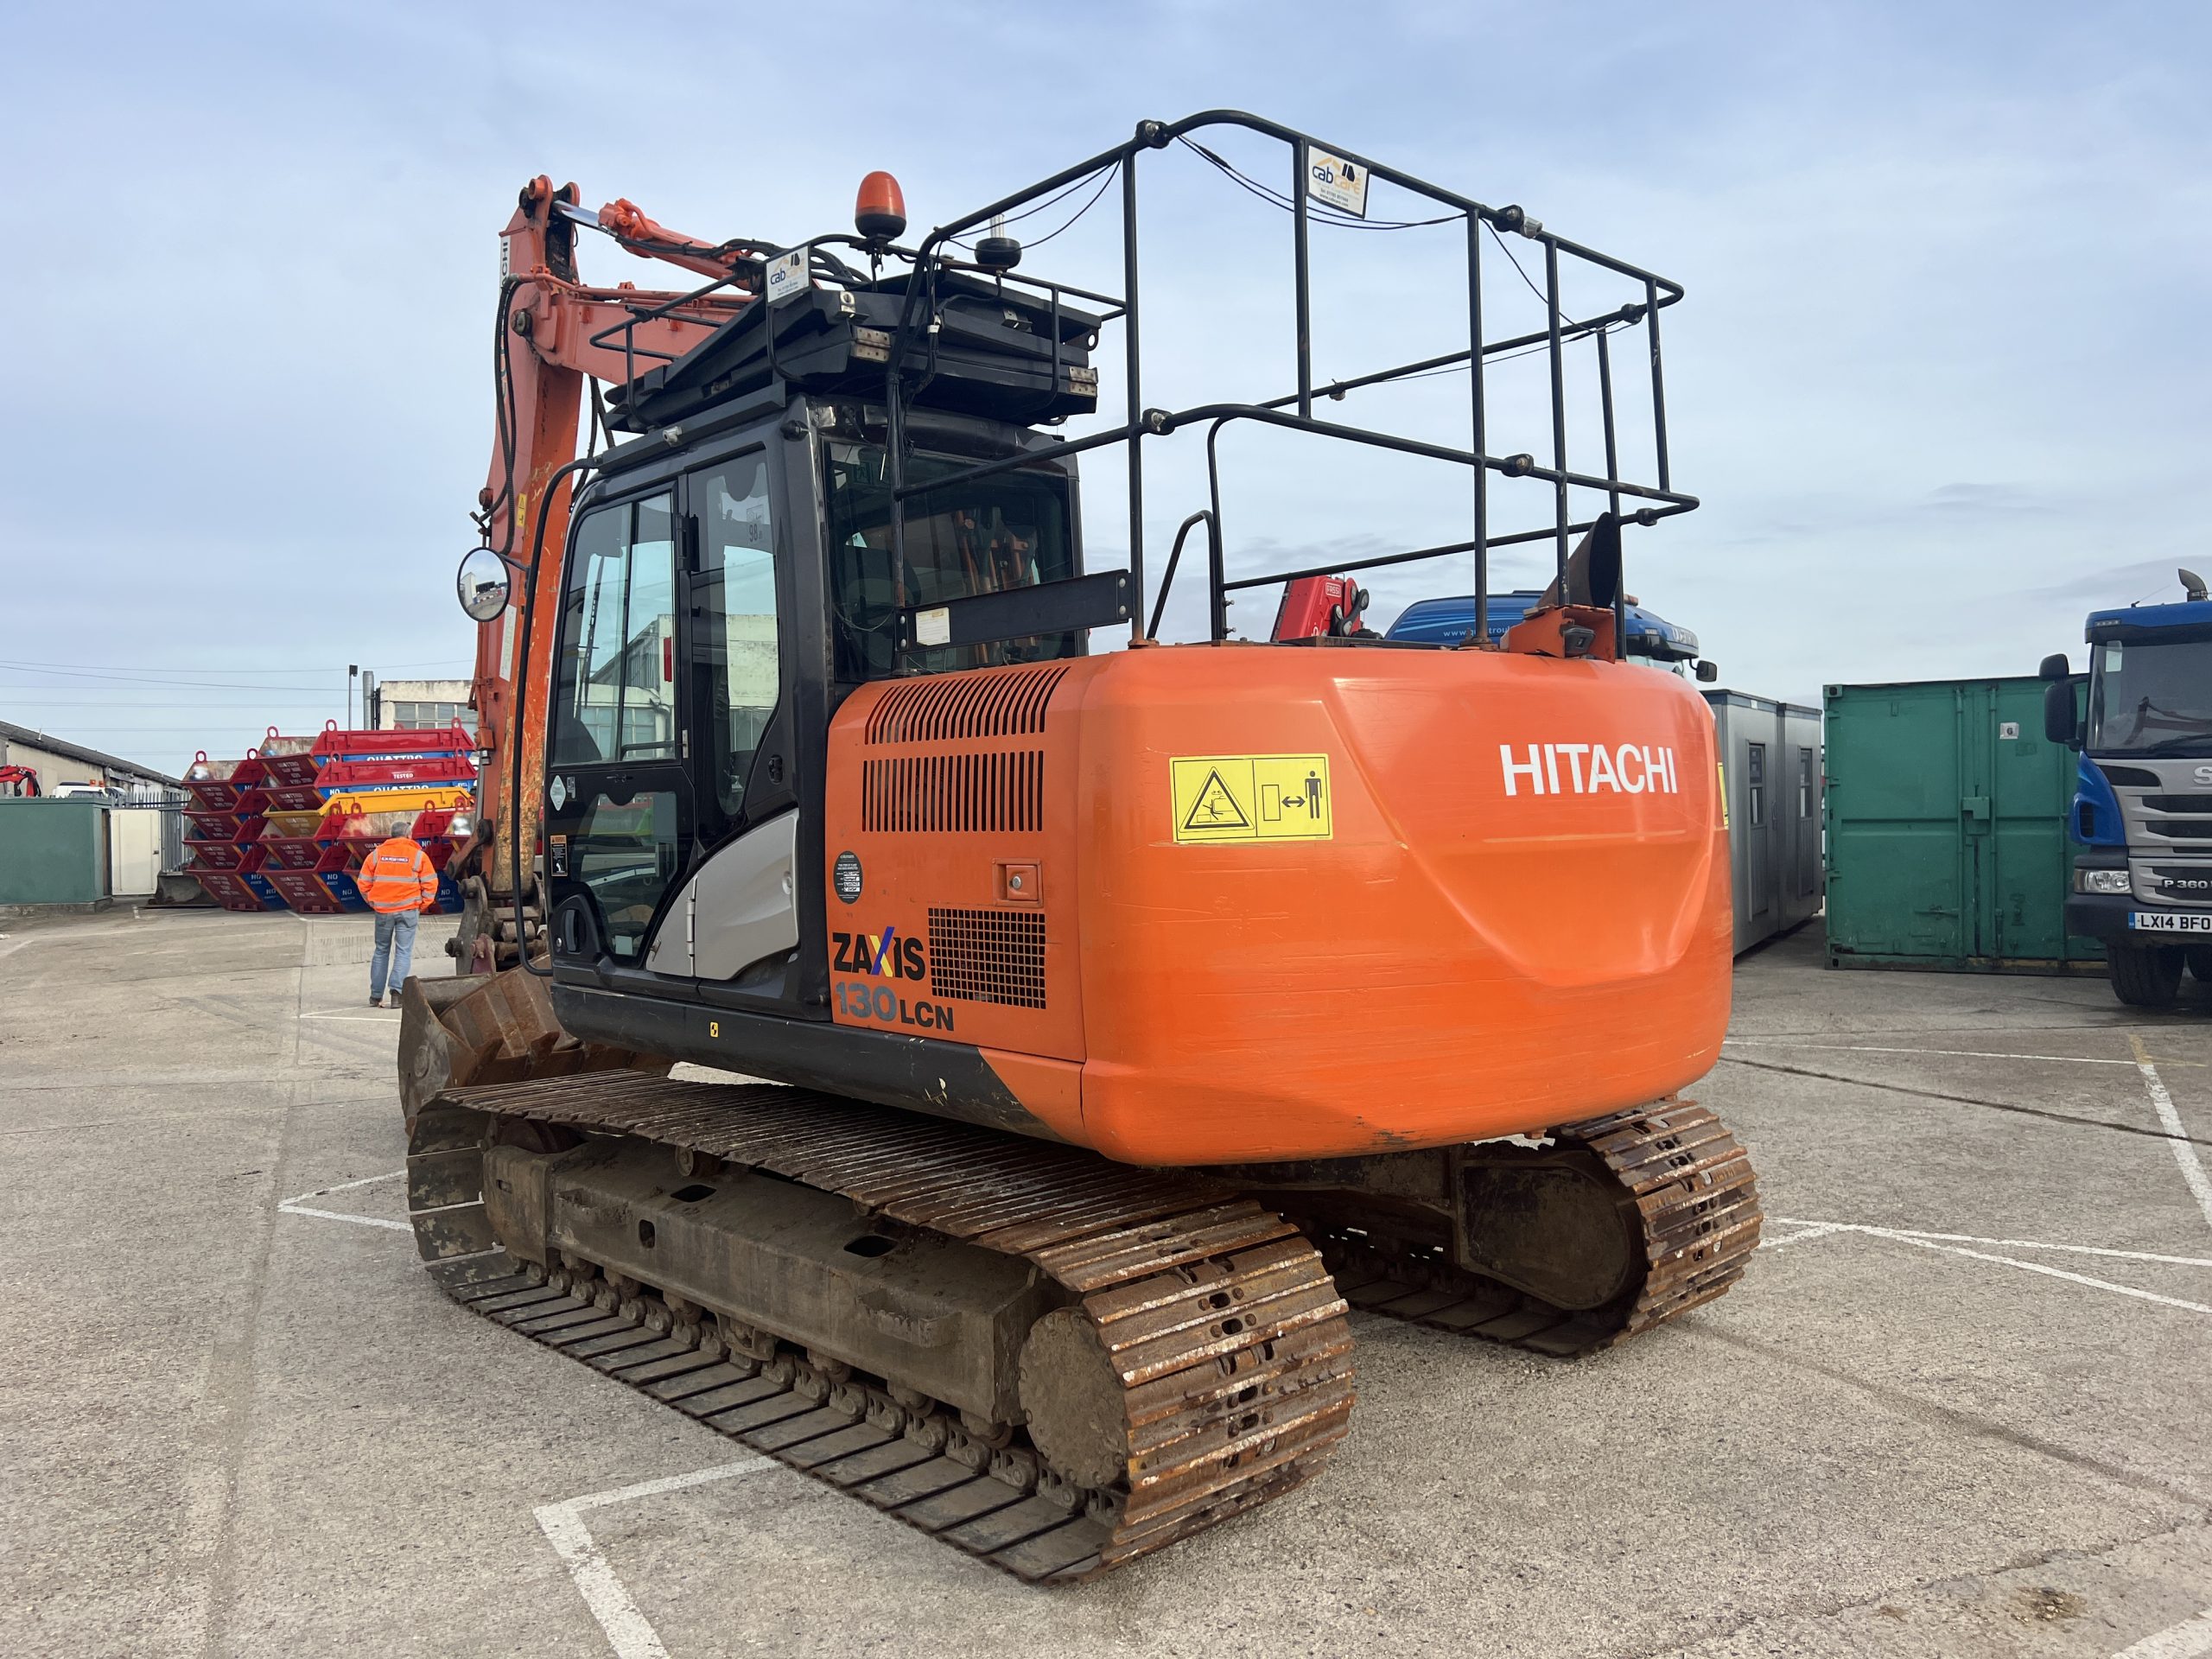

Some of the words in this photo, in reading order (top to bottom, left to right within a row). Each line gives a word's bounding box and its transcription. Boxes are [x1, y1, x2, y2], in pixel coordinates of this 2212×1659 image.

[749, 524, 758, 543] 98
[1499, 743, 1678, 796] HITACHI
[2164, 880, 2174, 888] P
[2177, 880, 2208, 889] 360
[2140, 914, 2175, 929] LX14
[2179, 916, 2211, 931] BFO
[832, 926, 925, 981] ZAXIS
[836, 982, 897, 1022] 130
[899, 999, 954, 1032] LCN
